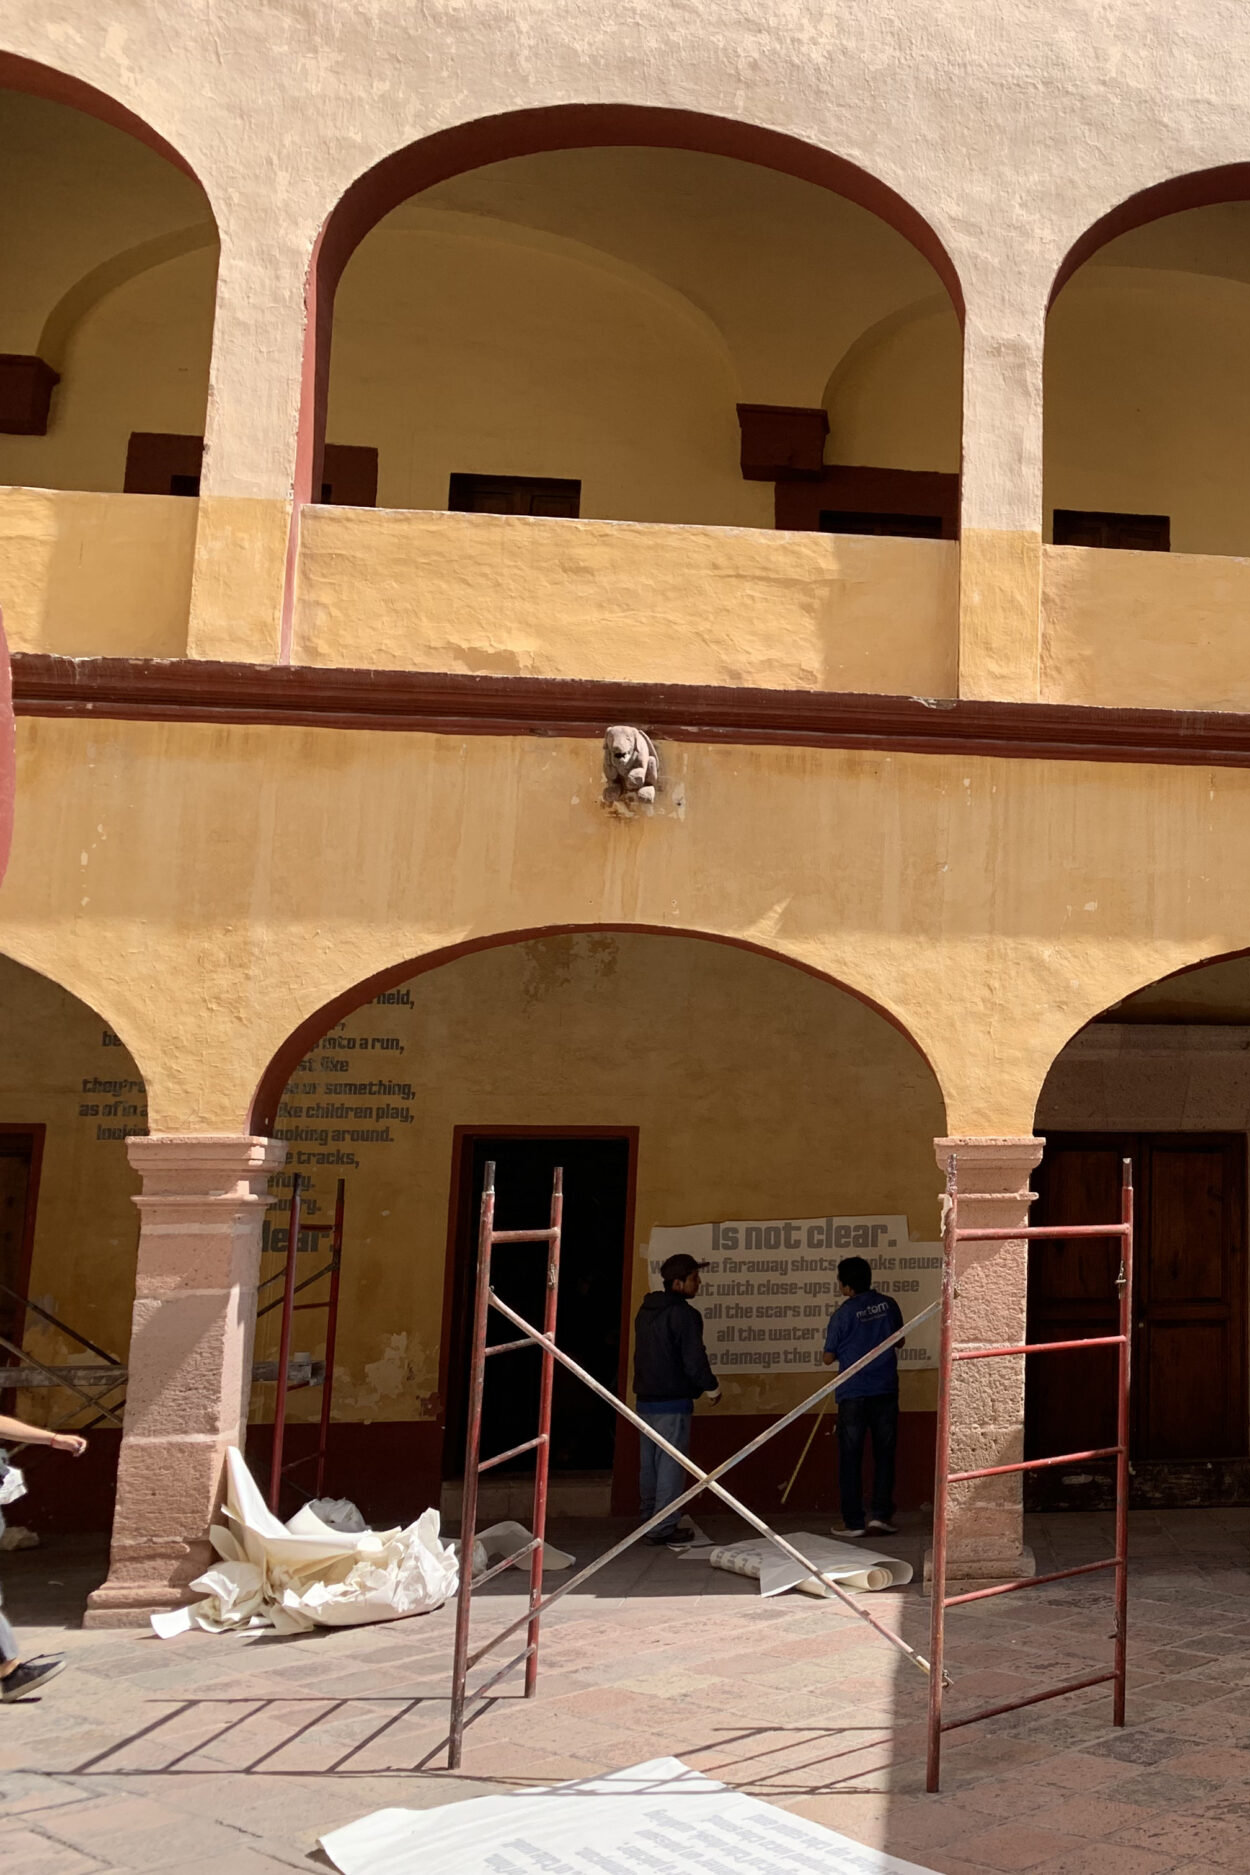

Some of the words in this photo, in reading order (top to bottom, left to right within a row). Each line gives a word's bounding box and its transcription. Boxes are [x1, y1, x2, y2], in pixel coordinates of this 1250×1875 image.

[371, 1037, 405, 1055] run,
[305, 1103, 374, 1119] children
[376, 1104, 415, 1124] play,
[331, 1127, 395, 1142] around.
[296, 1150, 360, 1168] tracks,
[744, 1222, 803, 1250] not
[806, 1217, 898, 1249] clear.
[722, 1257, 789, 1277] faraway
[791, 1256, 838, 1272] shots
[716, 1280, 755, 1297] with
[757, 1279, 831, 1298] close-ups
[892, 1279, 920, 1293] see
[704, 1304, 723, 1320] all
[725, 1302, 754, 1319] the
[755, 1304, 801, 1319] scars
[803, 1304, 822, 1318] on
[716, 1326, 735, 1342] all
[737, 1325, 766, 1342] the
[768, 1327, 820, 1342] water
[720, 1349, 781, 1368] damage
[783, 1348, 812, 1364] the
